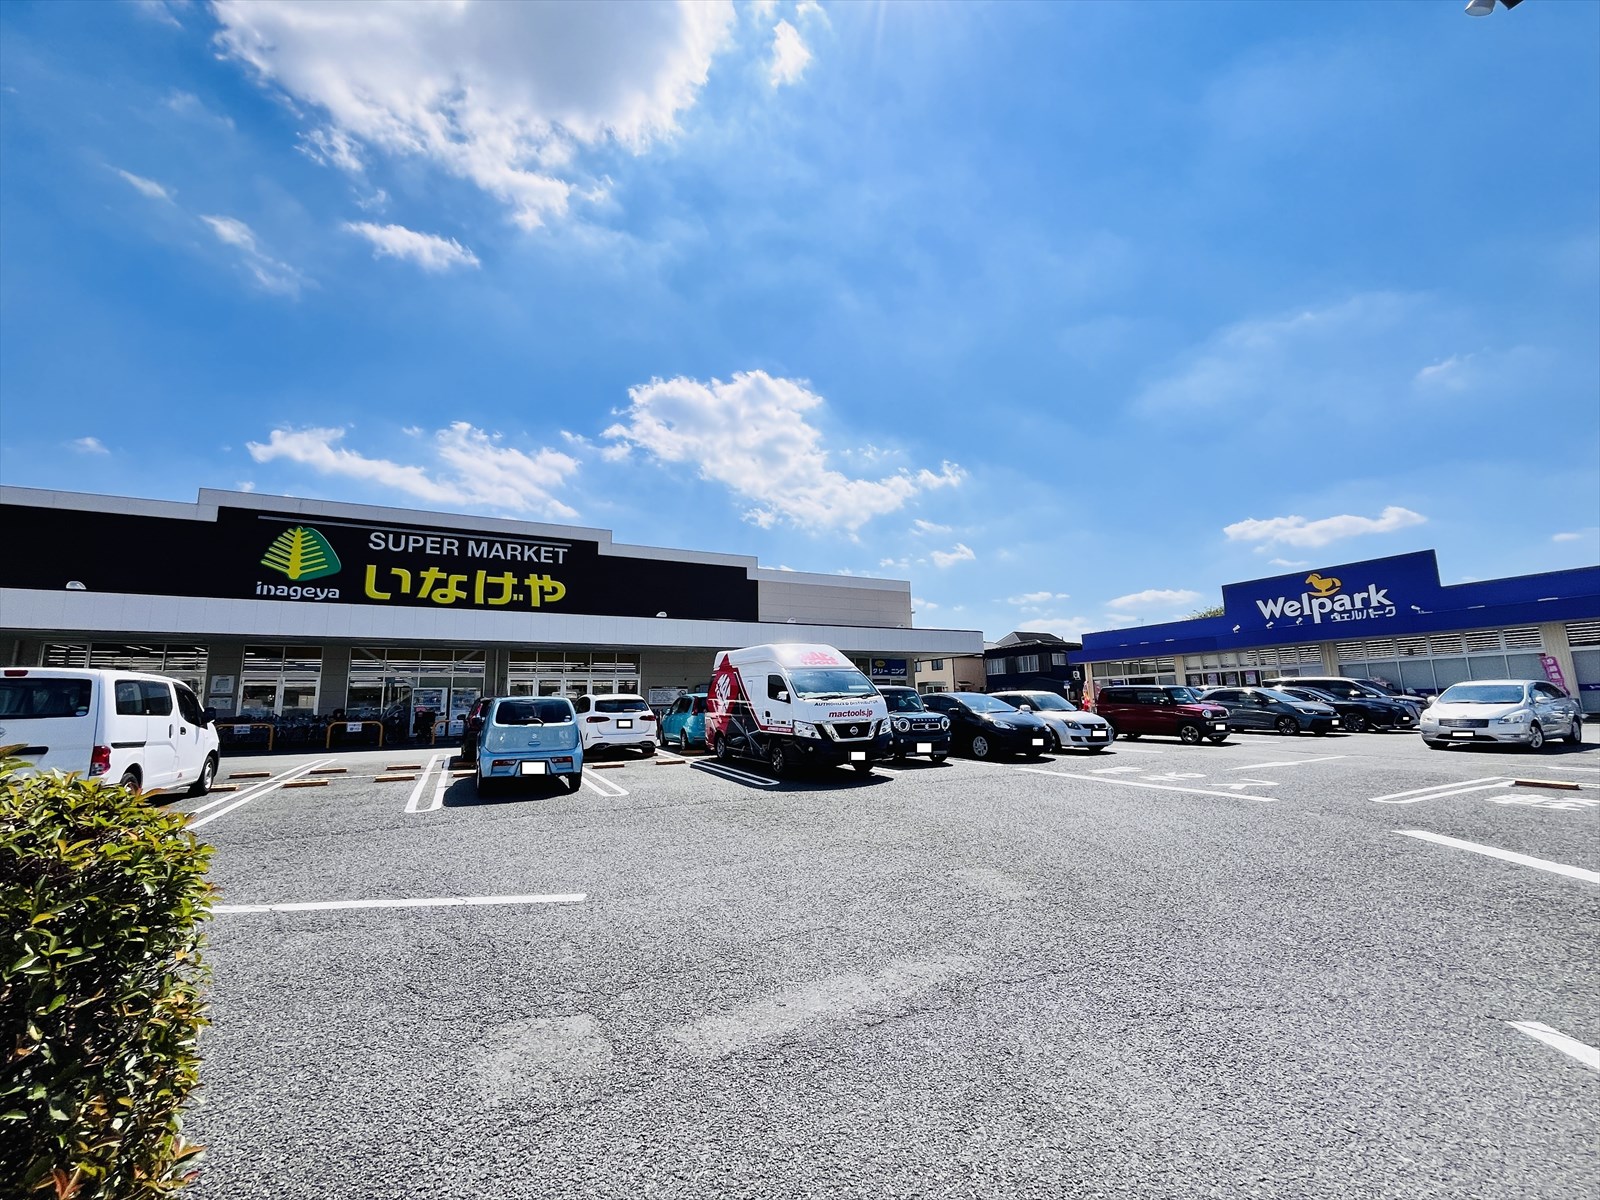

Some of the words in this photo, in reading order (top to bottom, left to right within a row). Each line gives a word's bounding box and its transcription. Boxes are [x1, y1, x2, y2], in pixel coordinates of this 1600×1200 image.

[368, 532, 459, 556] SUPER
[467, 540, 568, 565] MARKET
[255, 581, 340, 600] inageya
[364, 564, 566, 607] いなげや
[1256, 583, 1394, 624] Welpark
[1330, 605, 1396, 623] ウェルパーク
[828, 708, 874, 718] mactools.jp
